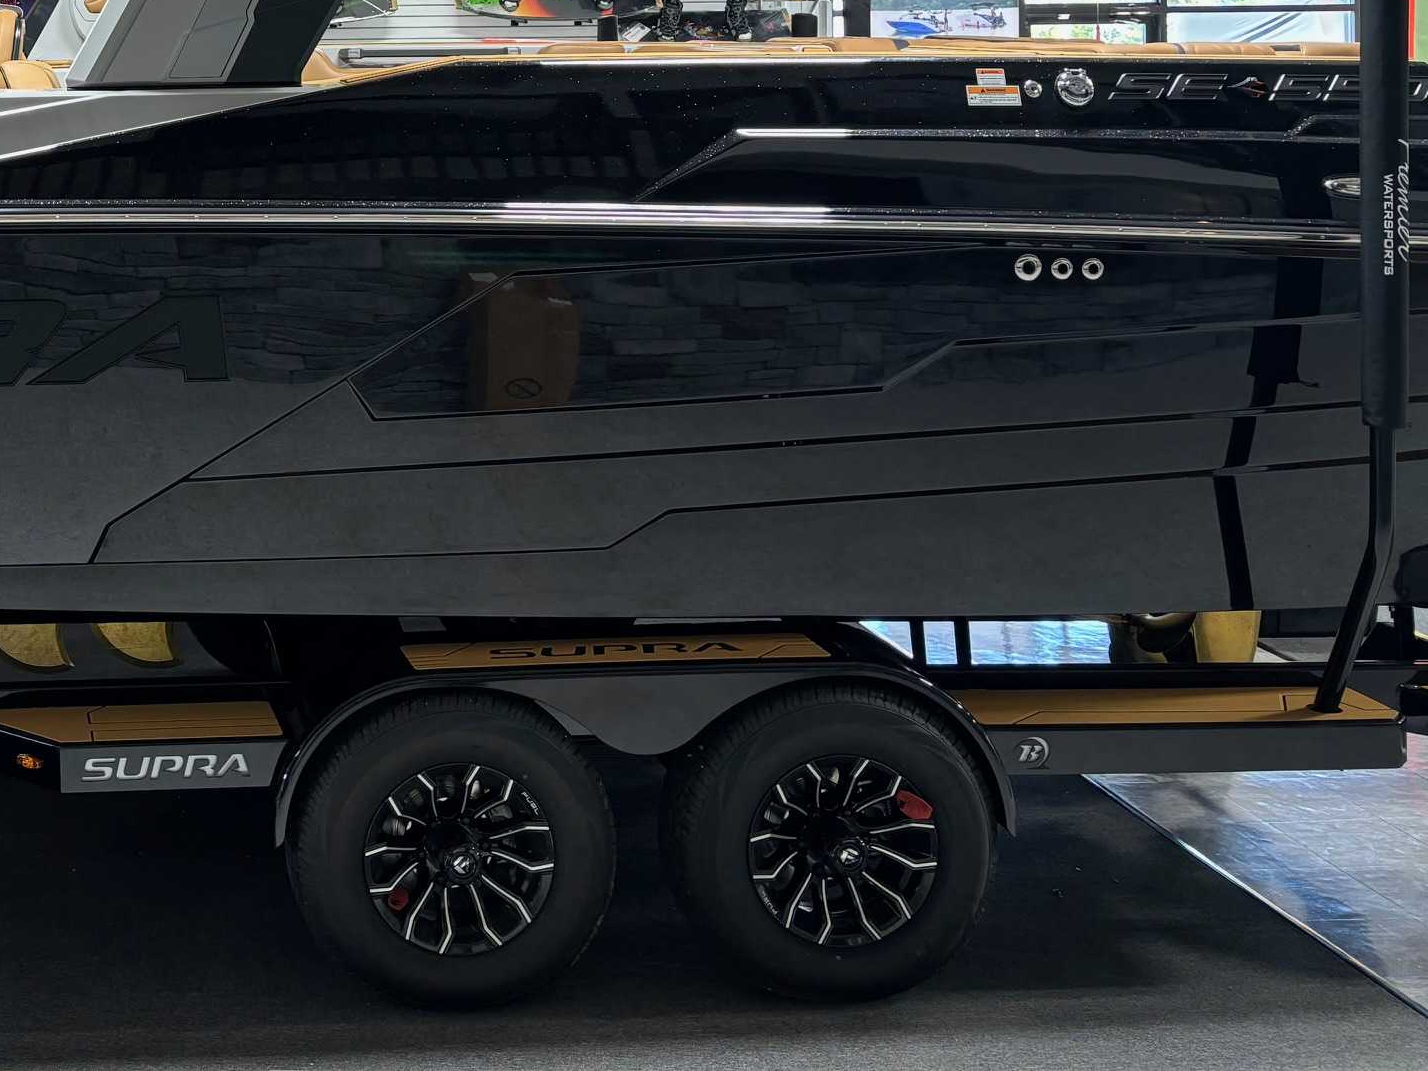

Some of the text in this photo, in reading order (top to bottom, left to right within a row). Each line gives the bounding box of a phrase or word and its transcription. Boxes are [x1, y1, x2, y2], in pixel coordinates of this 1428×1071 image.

[1383, 174, 1394, 276] WATERSPORTS
[489, 642, 745, 660] SUPRA
[82, 753, 251, 782] SUPRA
